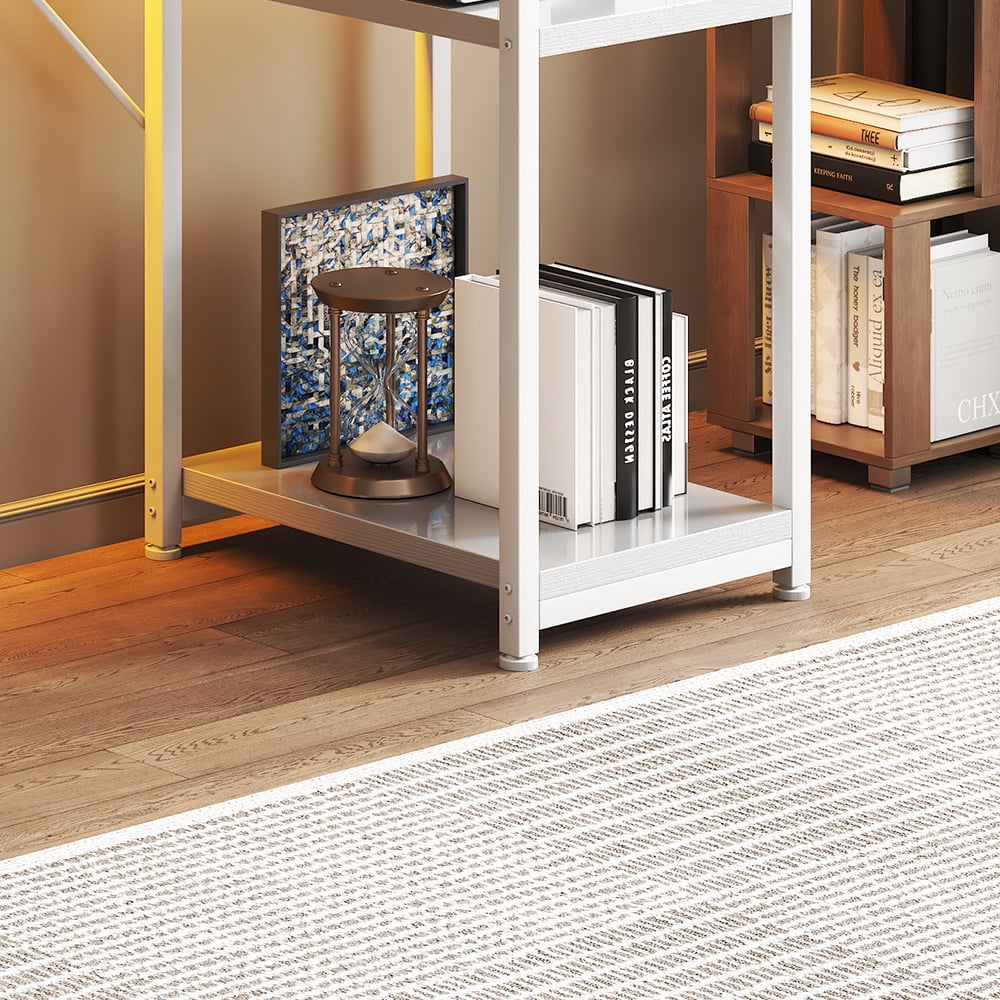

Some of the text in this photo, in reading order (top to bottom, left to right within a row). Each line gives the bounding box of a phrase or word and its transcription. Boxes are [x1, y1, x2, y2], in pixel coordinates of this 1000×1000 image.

[861, 129, 880, 145] THEE
[814, 167, 852, 182] KEEPING FAITH
[852, 286, 860, 312] honey
[873, 294, 883, 314] ex
[852, 315, 860, 348] badger
[869, 319, 884, 384] Aliquid
[958, 391, 1000, 424] CHX
